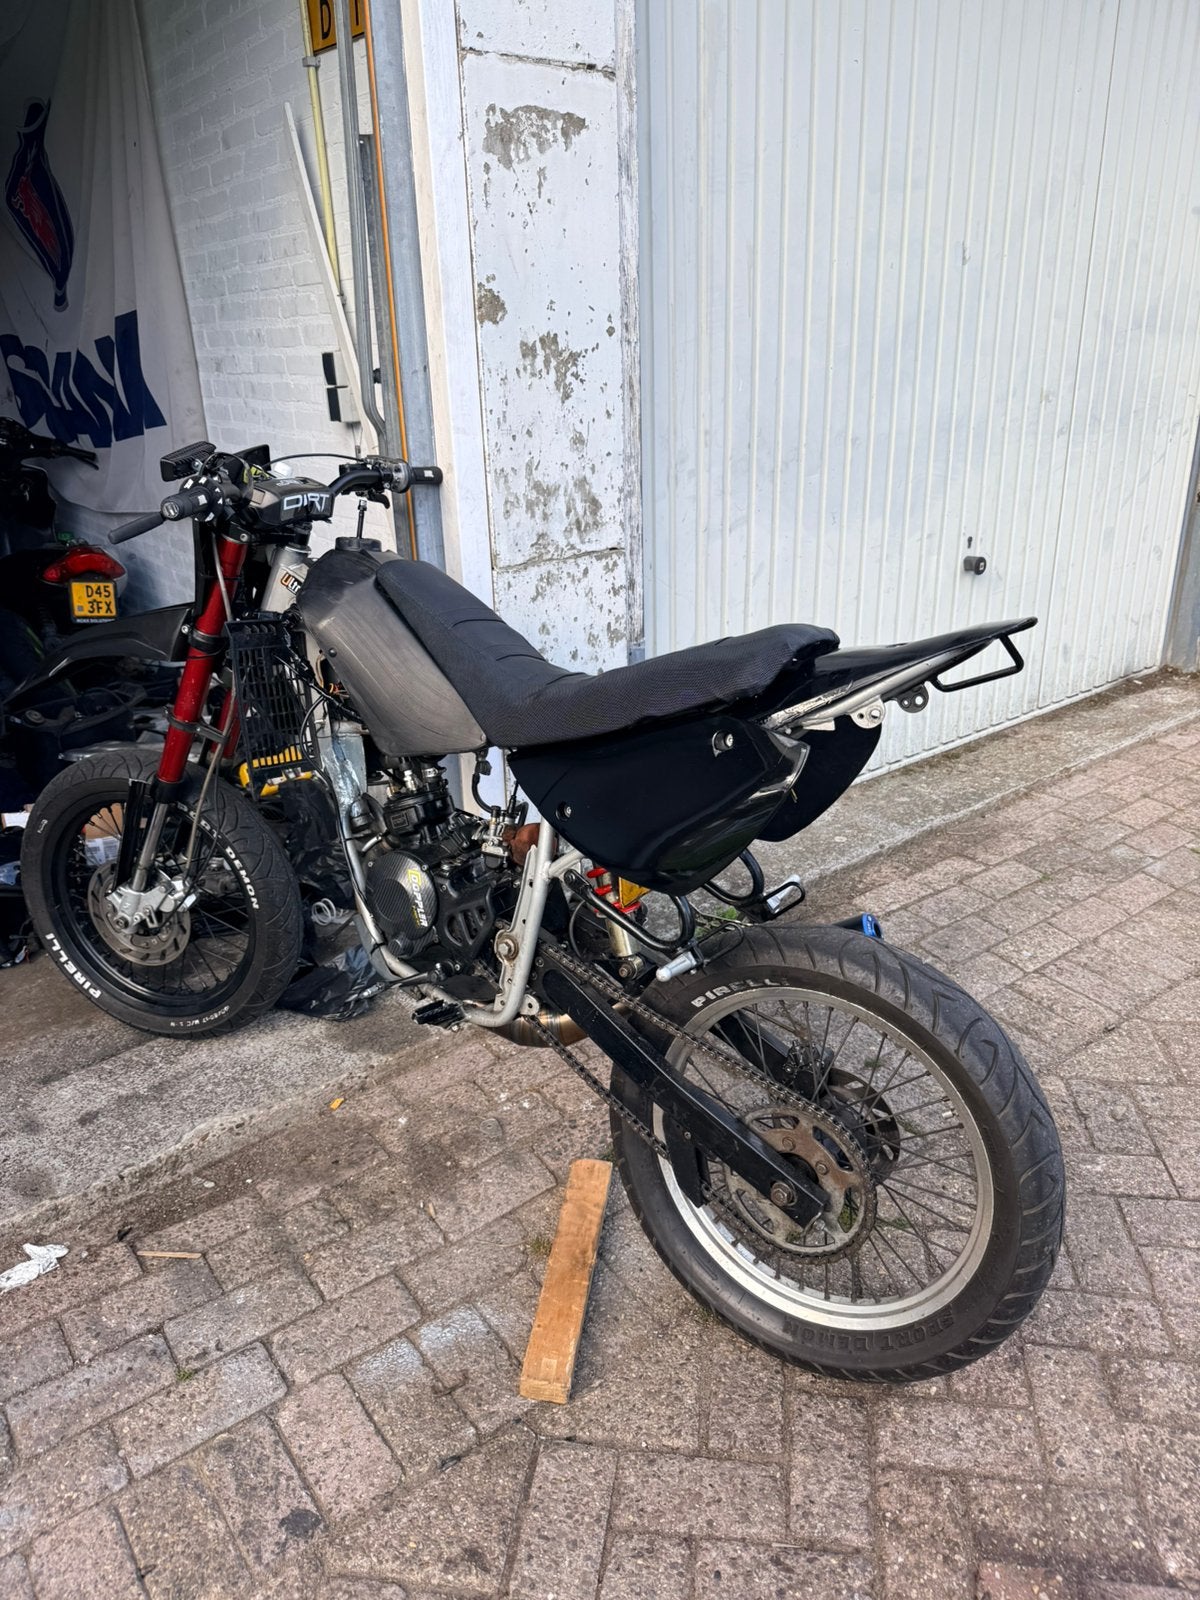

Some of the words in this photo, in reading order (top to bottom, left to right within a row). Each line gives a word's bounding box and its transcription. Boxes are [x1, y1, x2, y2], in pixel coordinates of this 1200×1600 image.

[283, 492, 330, 513] DIRT
[85, 584, 112, 598] D45
[87, 600, 113, 614] 3FX
[225, 845, 260, 909] DEMON
[410, 873, 429, 928] DOPPLER
[45, 932, 102, 999] PIRELLI
[690, 978, 790, 1008] PIRELLI
[879, 1311, 954, 1351] SPORT
